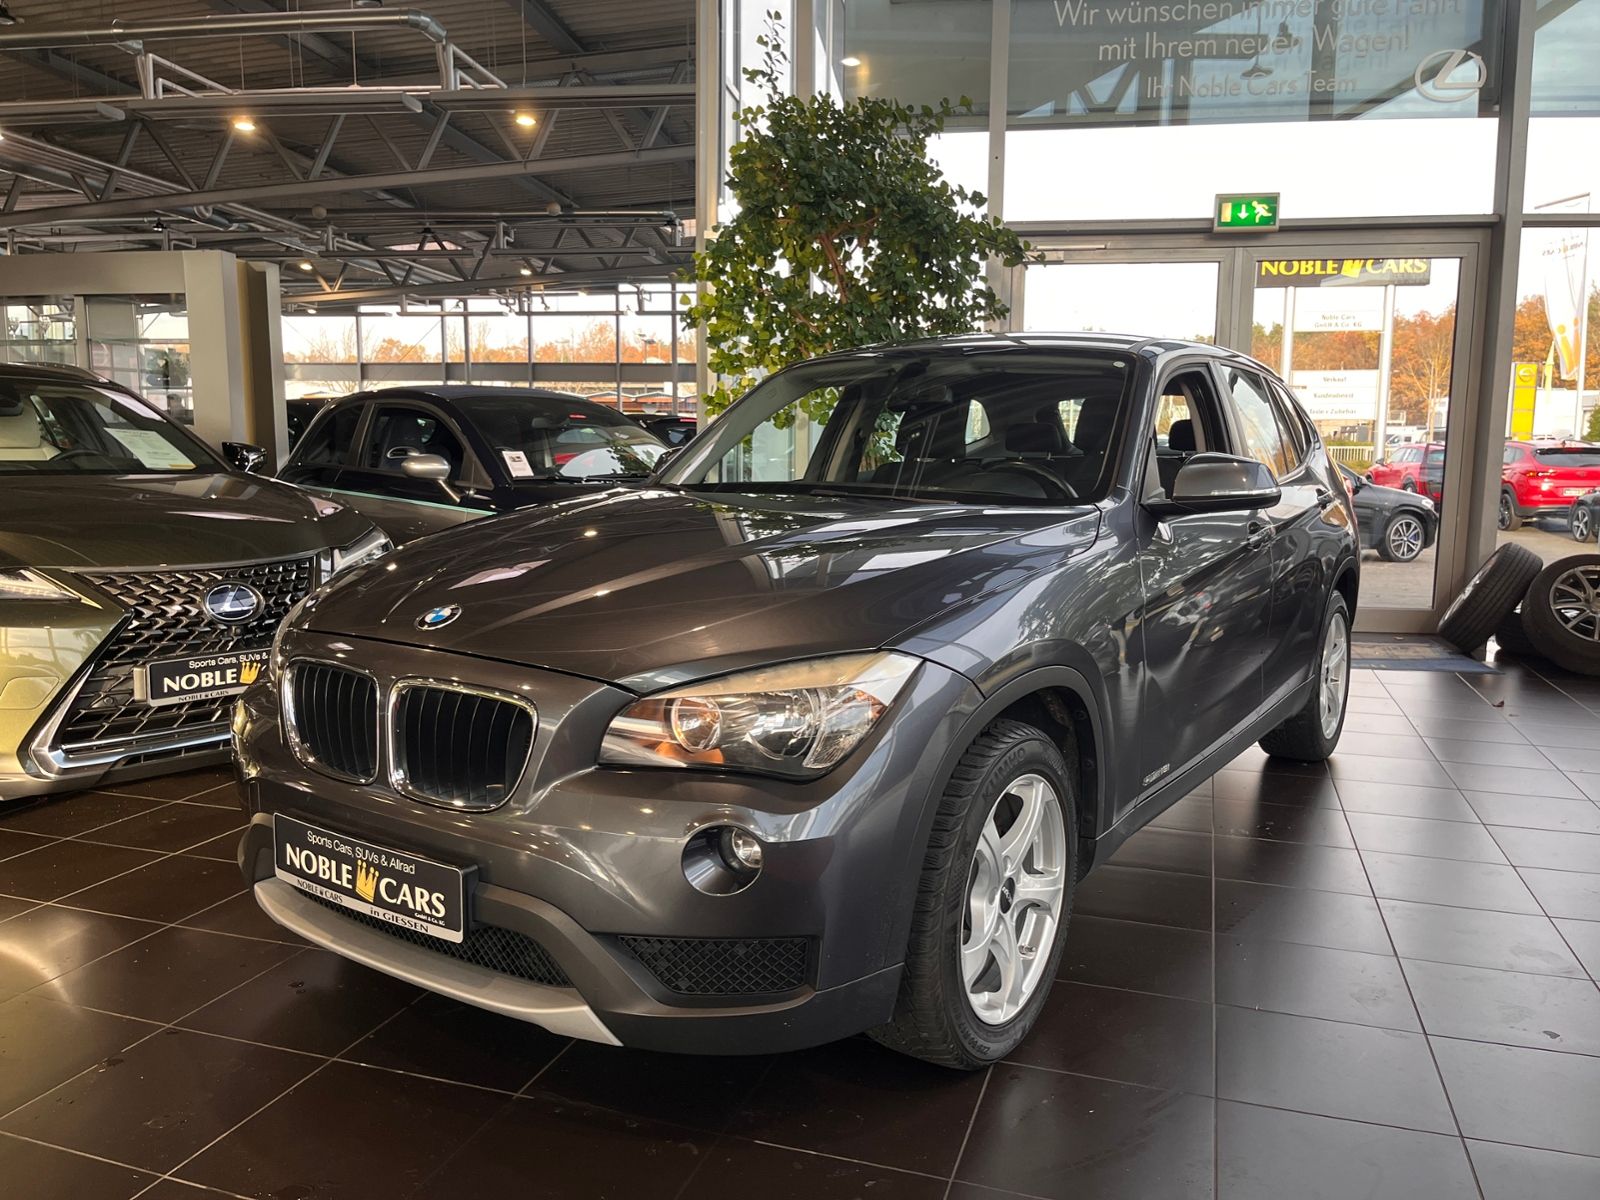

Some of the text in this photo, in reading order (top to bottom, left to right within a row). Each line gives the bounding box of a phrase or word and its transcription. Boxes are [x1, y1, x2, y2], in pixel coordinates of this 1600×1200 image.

[1054, 0, 1099, 26] Wir
[1106, 0, 1233, 24] wünschen
[1240, 0, 1319, 19] immer
[1098, 24, 1409, 61] mit Ihrem neuen Wagen!
[1147, 70, 1358, 98] Ihr Noble Cars Team
[1261, 258, 1428, 276] NOBLE CARS
[189, 652, 268, 669] Sports Cars, SUVs &
[163, 668, 237, 693] NOBLE
[178, 690, 229, 702] NOBLE CARS
[982, 747, 1026, 798] KUMHO
[307, 830, 416, 875] Sports Cars, SUVs & Allrad
[286, 842, 446, 918] NOBLE CARS
[297, 878, 343, 904] NOBLE CARS
[370, 906, 429, 934] in GIESSEN
